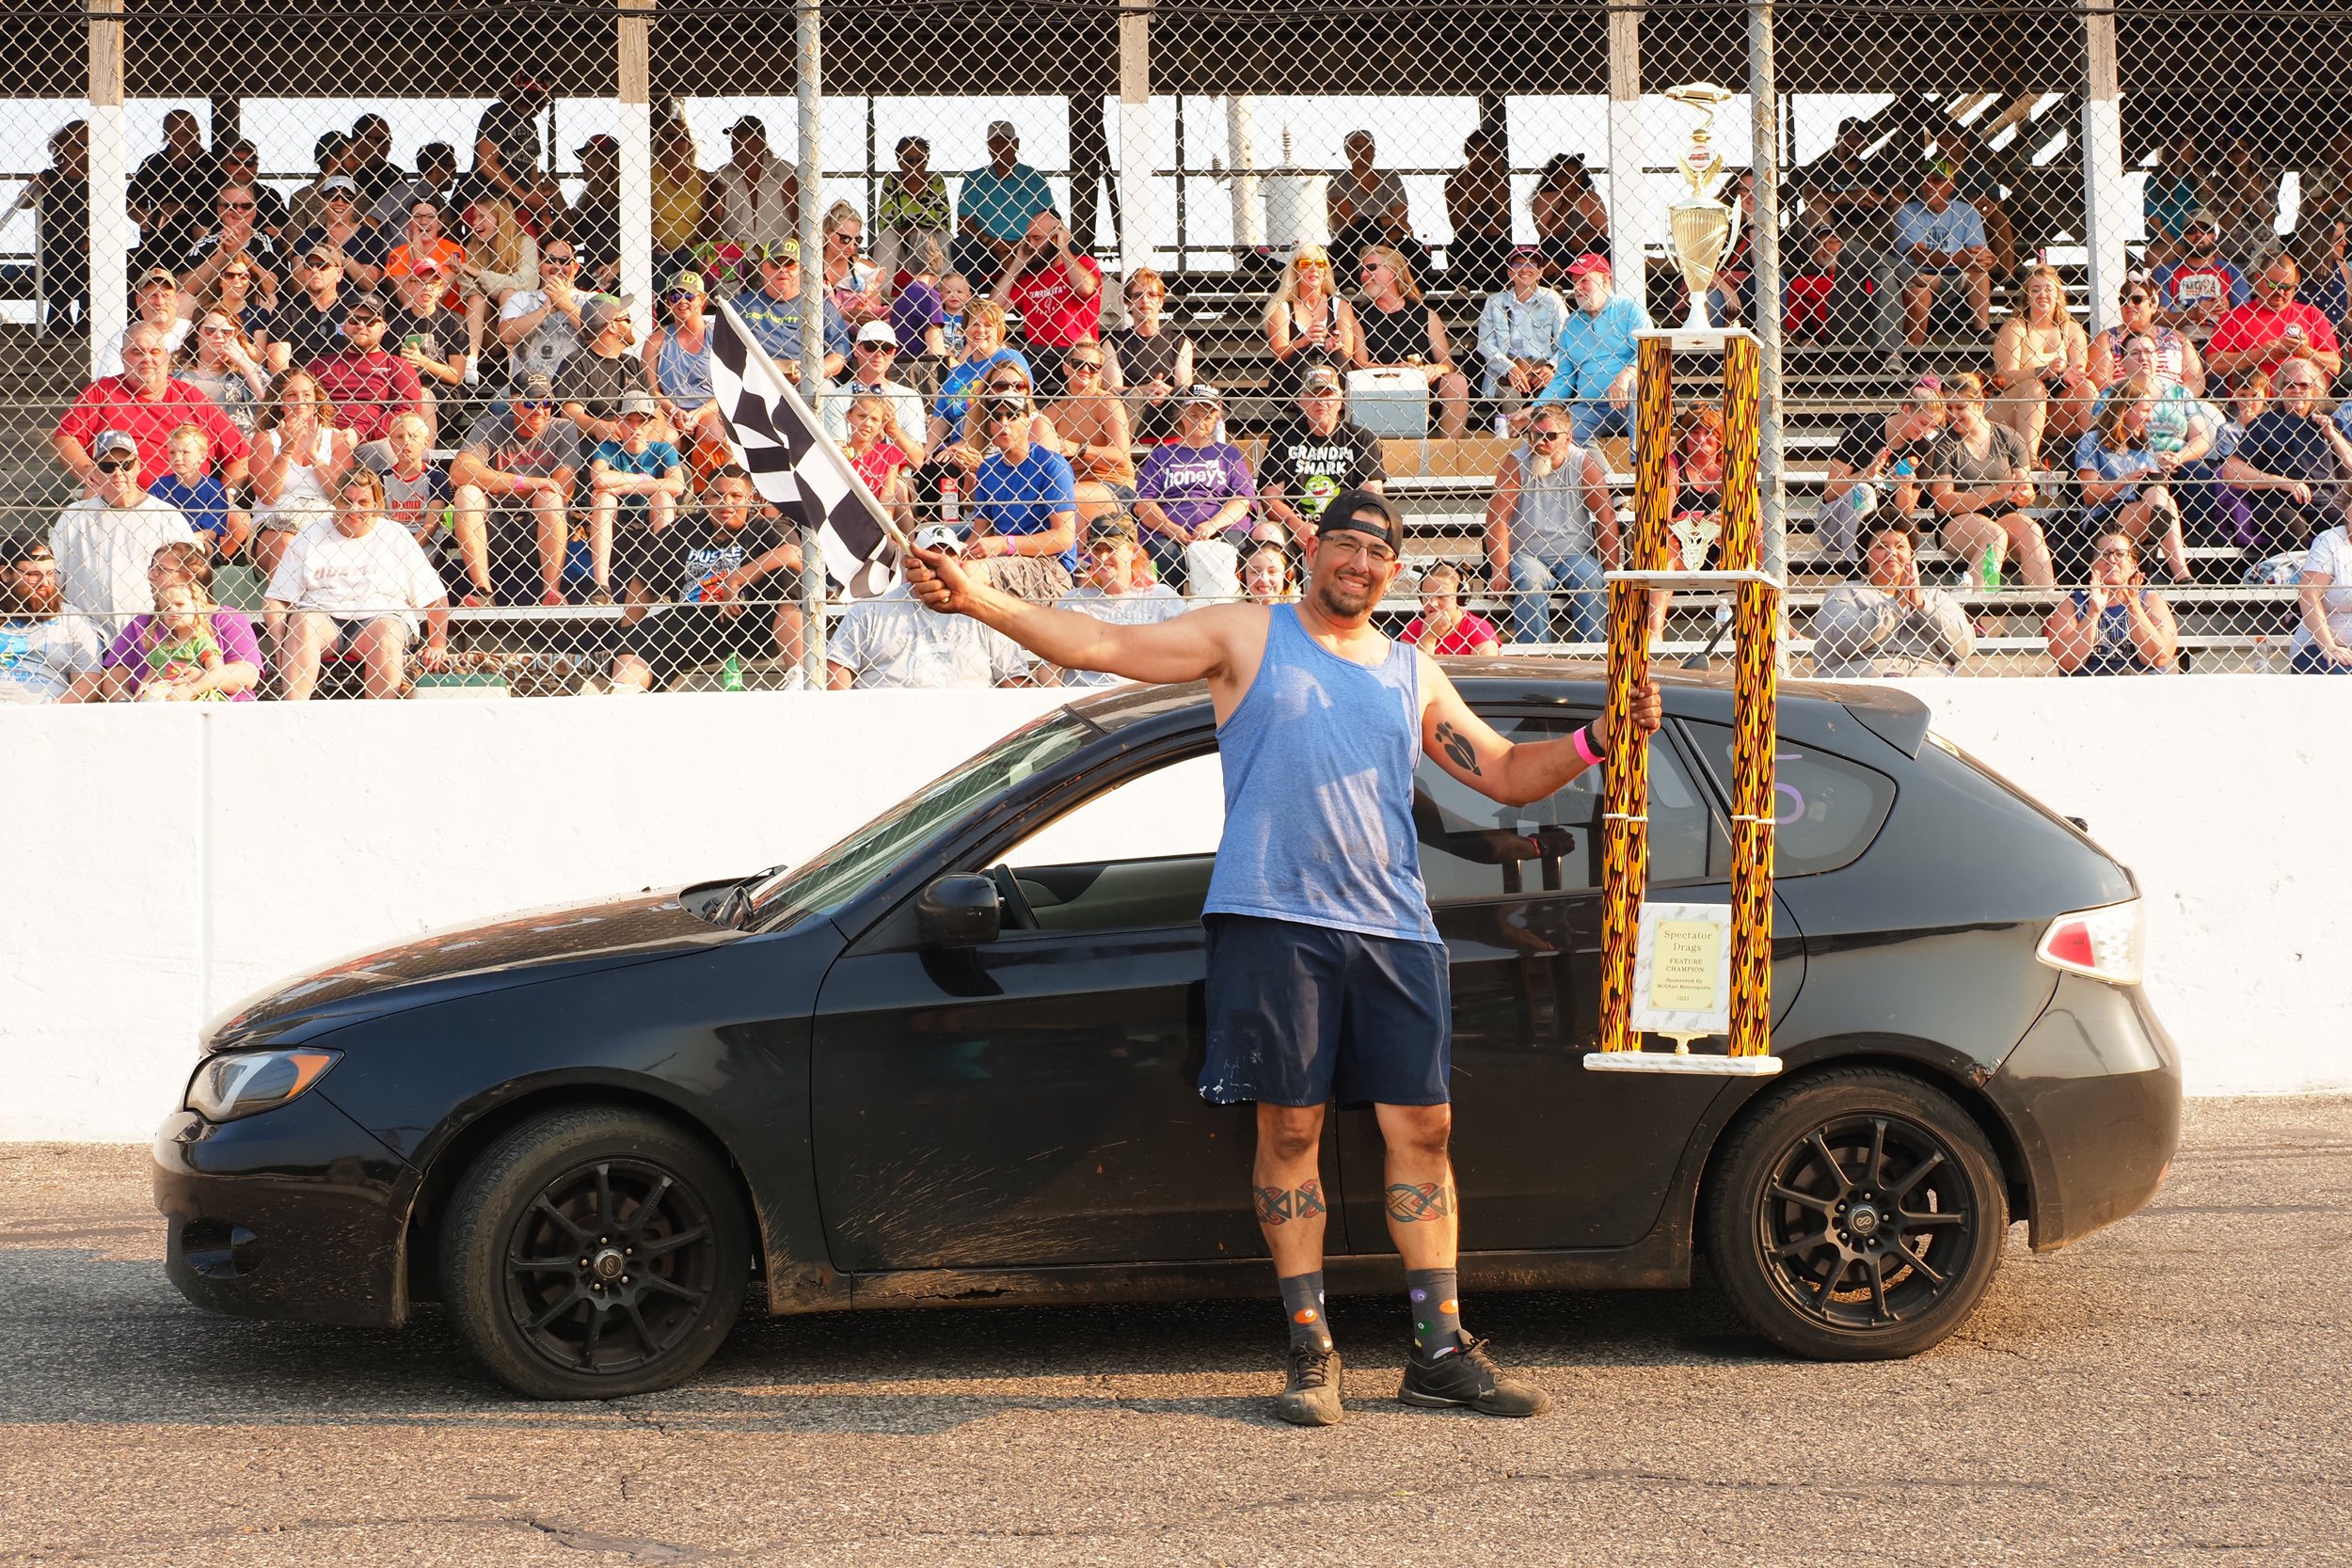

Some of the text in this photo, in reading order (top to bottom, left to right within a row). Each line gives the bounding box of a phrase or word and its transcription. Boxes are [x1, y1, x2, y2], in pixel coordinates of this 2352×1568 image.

[1288, 445, 1354, 462] GRANDPA
[1295, 459, 1347, 475] SHARK
[1663, 930, 1712, 941] Spectator
[1673, 942, 1702, 953] Drags
